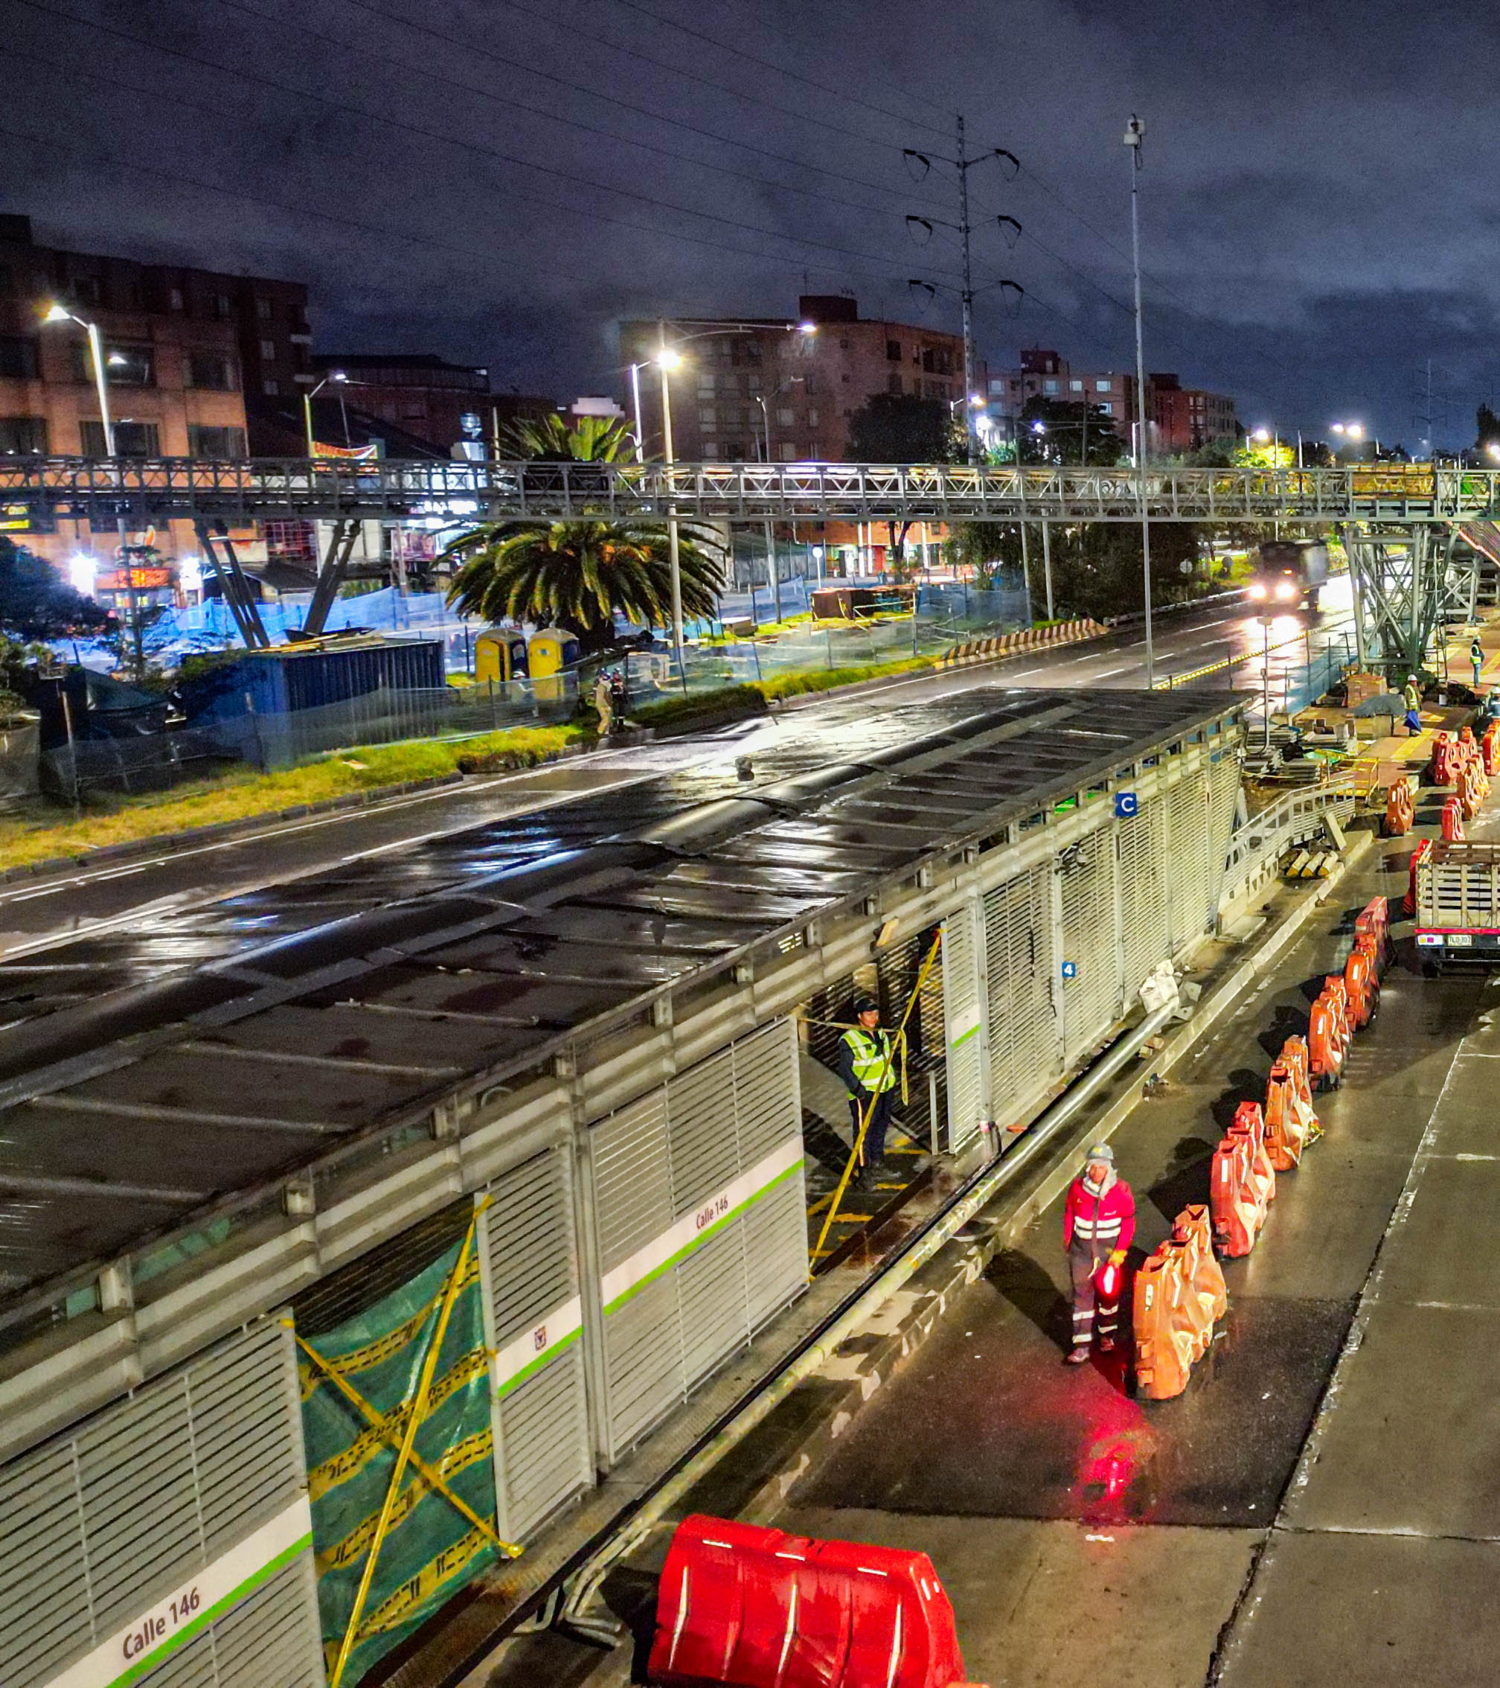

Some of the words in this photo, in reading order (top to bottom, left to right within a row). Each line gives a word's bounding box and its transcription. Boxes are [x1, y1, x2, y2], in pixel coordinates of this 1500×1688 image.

[1121, 796, 1135, 812] C
[1064, 964, 1073, 975] 4
[696, 1208, 714, 1230] Calle
[715, 1195, 729, 1215] 146
[123, 1617, 166, 1660] Calle
[169, 1586, 200, 1625] 146
